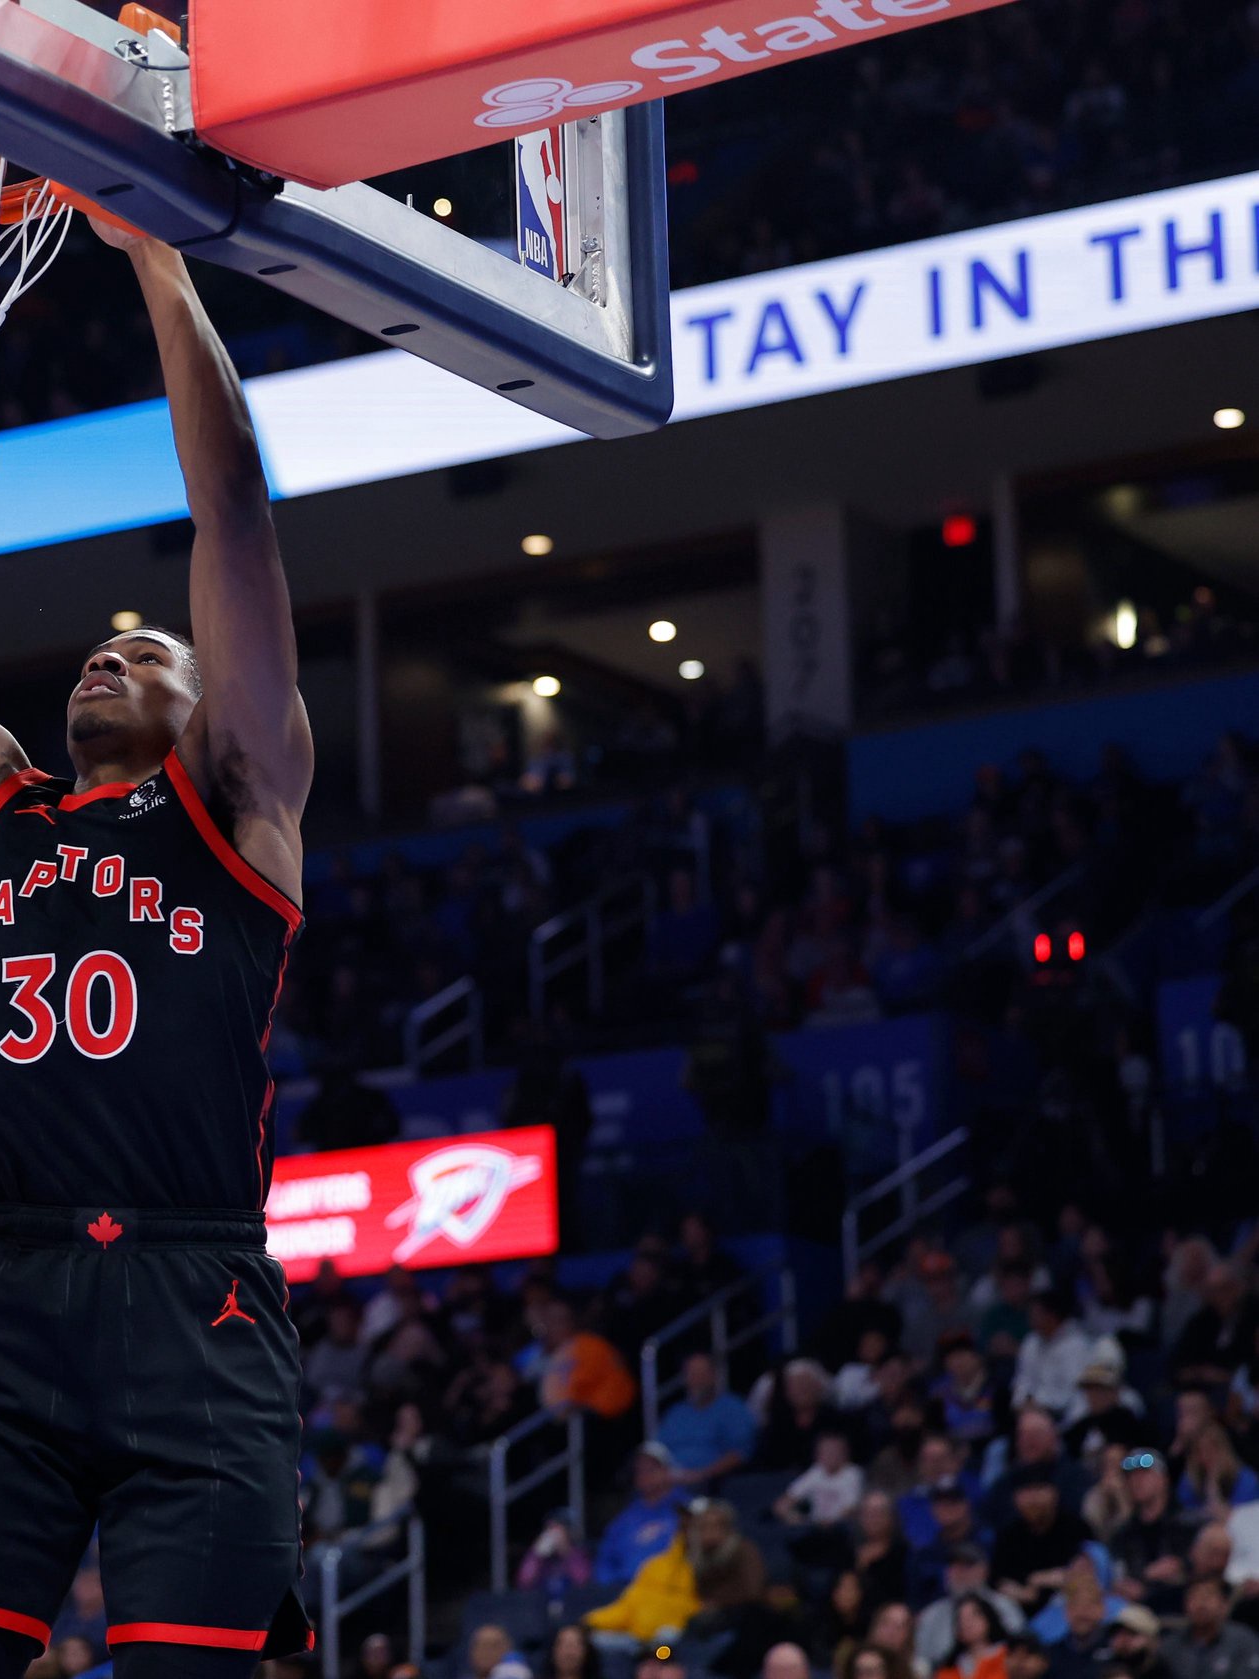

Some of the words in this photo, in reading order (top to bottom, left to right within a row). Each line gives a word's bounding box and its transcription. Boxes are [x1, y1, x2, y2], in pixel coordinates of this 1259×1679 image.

[525, 227, 549, 268] NBA
[926, 247, 1033, 339] IN
[1088, 204, 1259, 303] TH
[118, 809, 143, 820] Sun
[144, 795, 167, 812] Life
